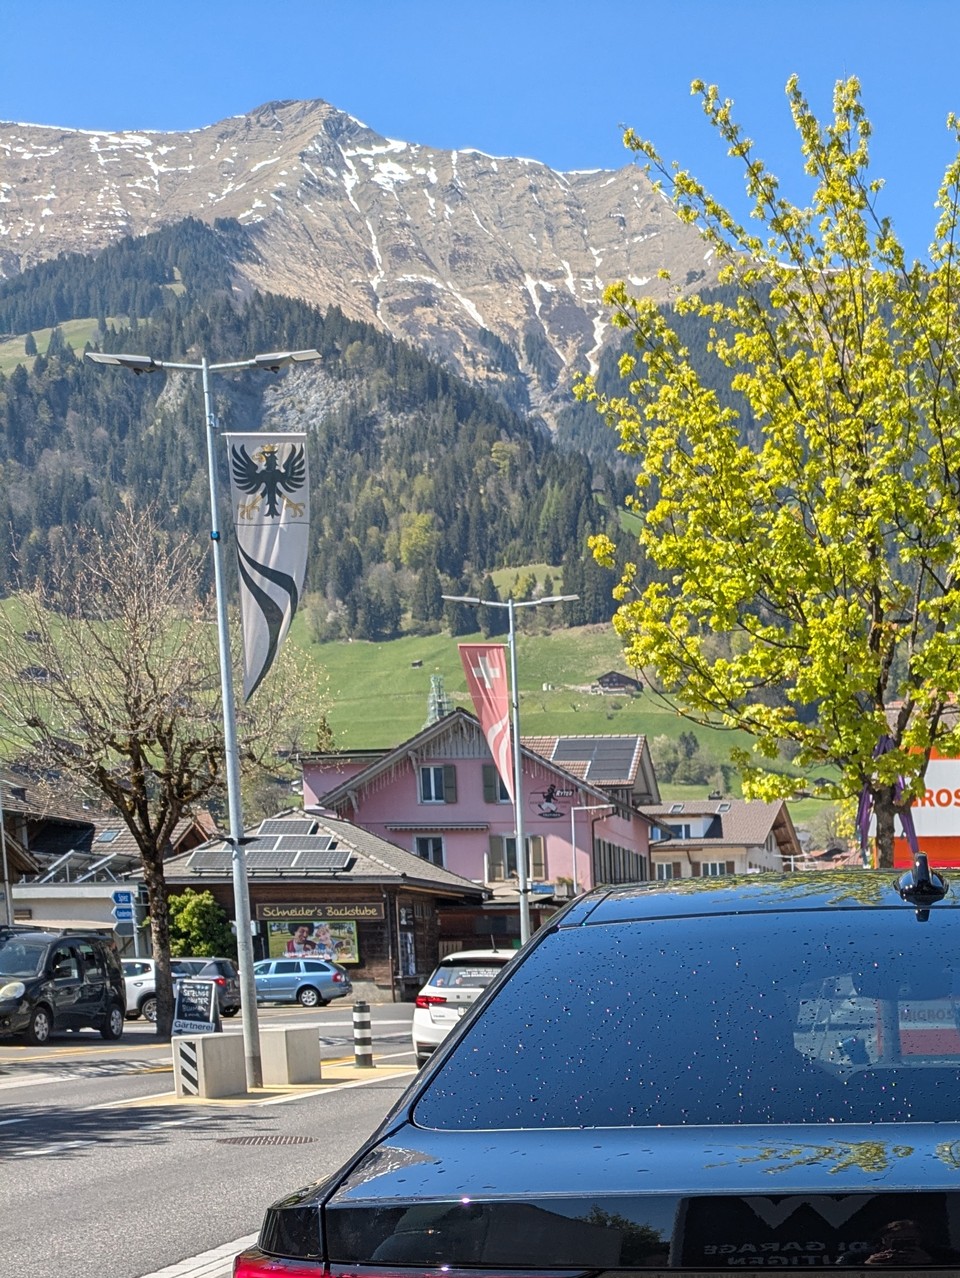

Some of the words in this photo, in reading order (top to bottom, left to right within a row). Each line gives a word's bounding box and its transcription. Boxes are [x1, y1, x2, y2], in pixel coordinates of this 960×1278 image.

[262, 906, 322, 917] Schneider's
[326, 906, 378, 916] Backstube
[174, 1020, 213, 1031] Gärtnerei
